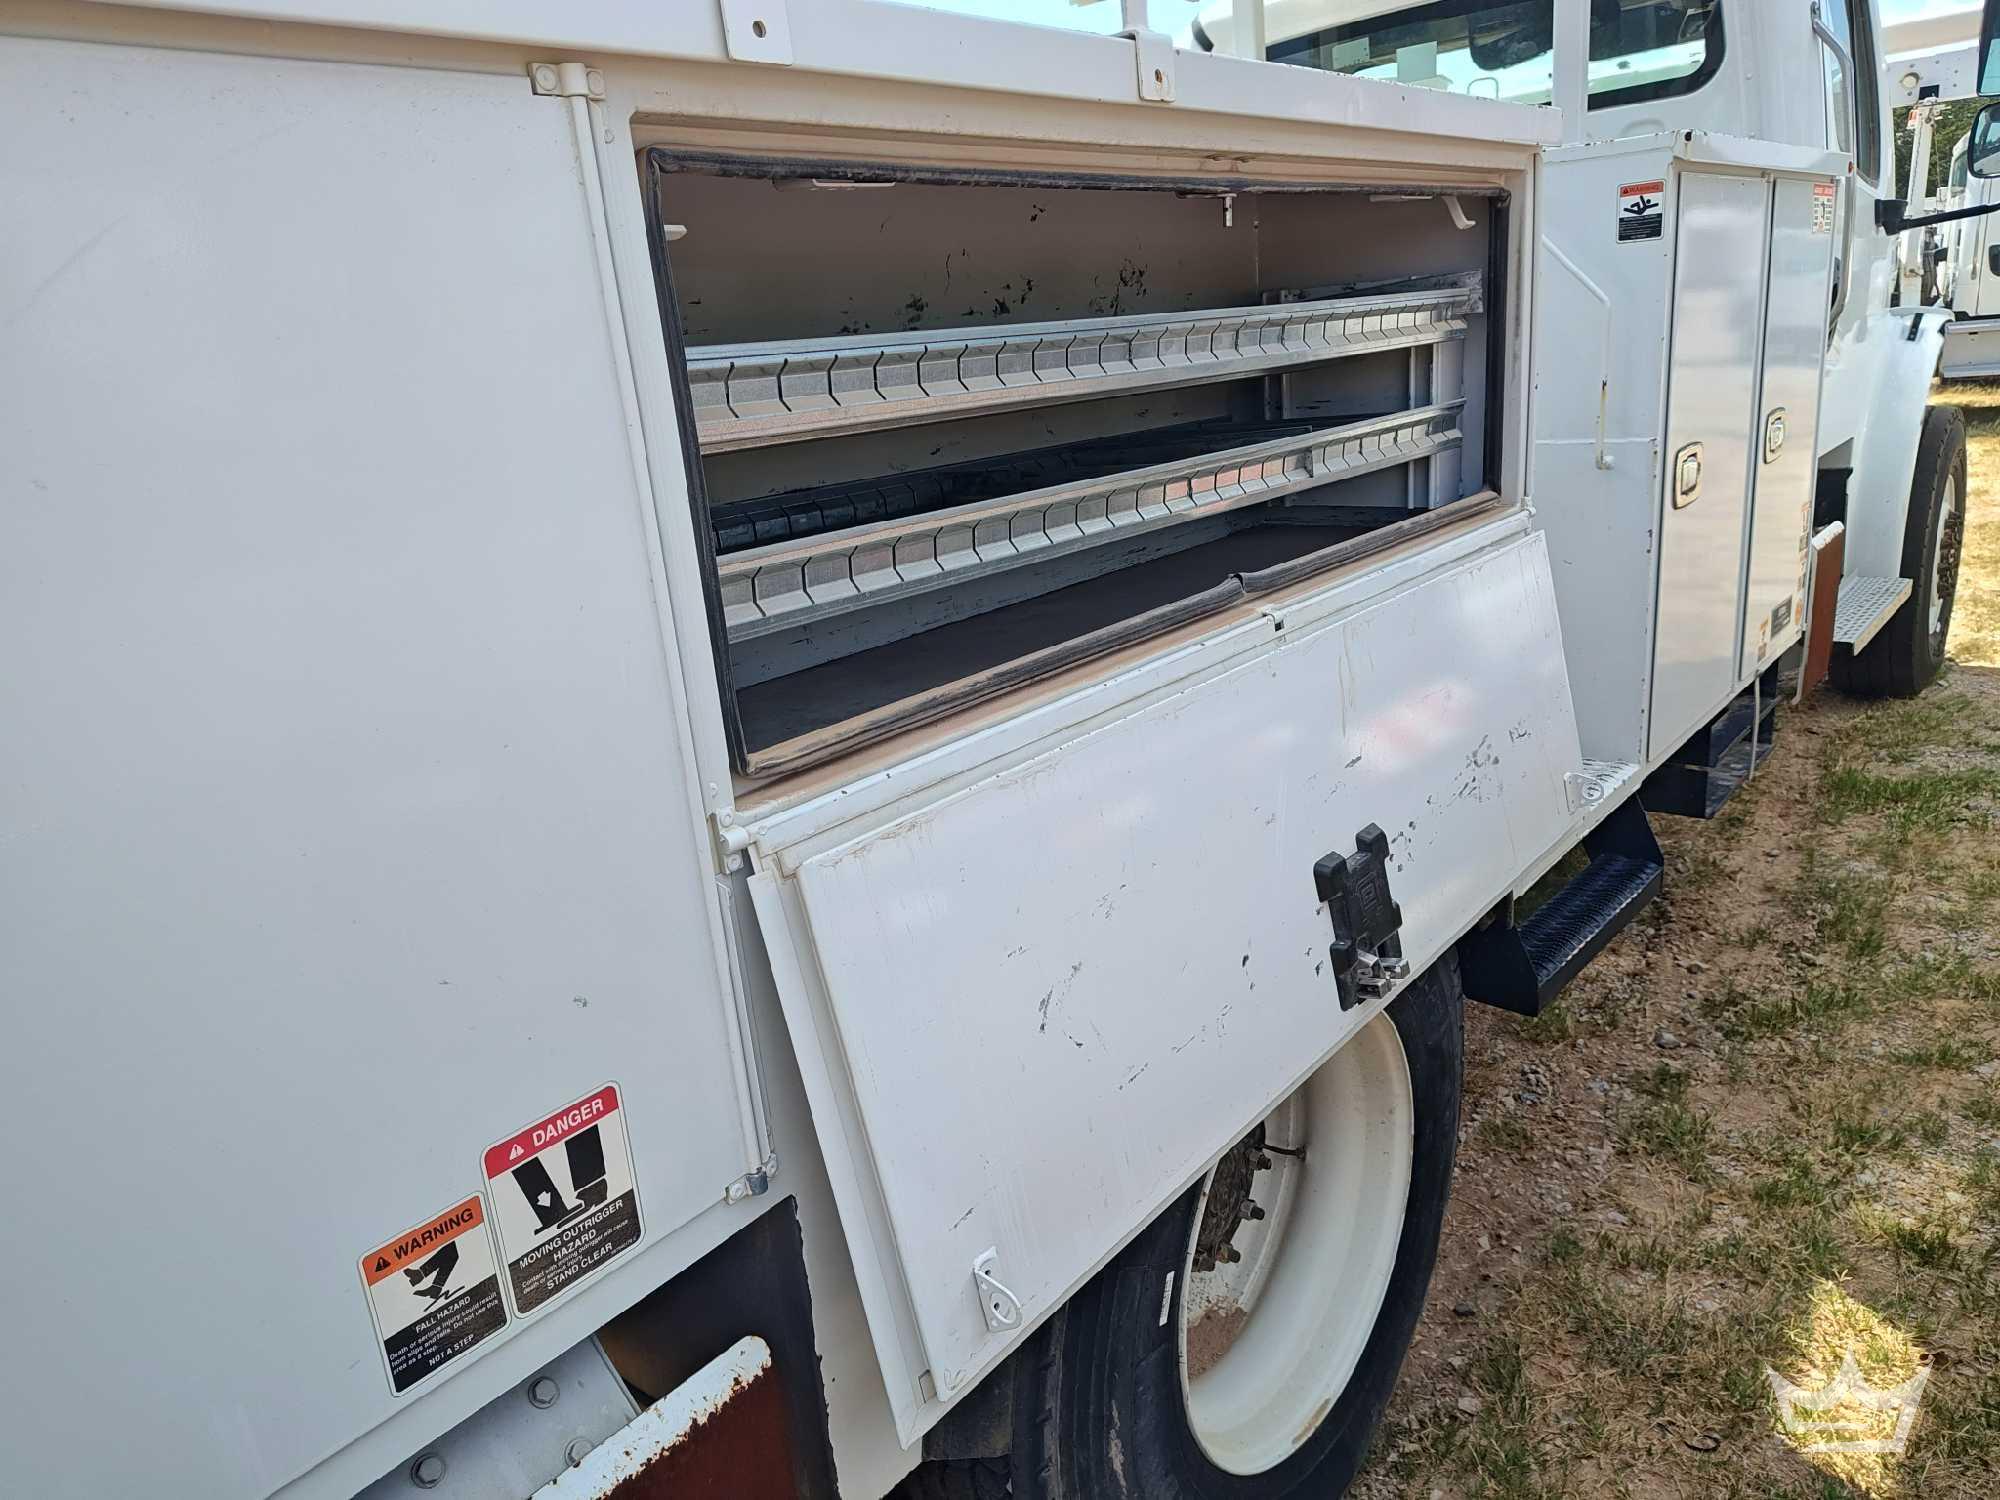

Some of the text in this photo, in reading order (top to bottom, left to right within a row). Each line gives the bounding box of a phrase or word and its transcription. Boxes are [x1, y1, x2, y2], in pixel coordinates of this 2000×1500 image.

[532, 1098, 604, 1146] DANGER
[394, 1208, 474, 1261] WARNING
[519, 1238, 561, 1269] MOVING
[563, 1200, 623, 1240] OUTRIGGER
[553, 1229, 596, 1262] HAZARD
[546, 1263, 579, 1290] STAND
[580, 1242, 613, 1268] CLEAR
[415, 1296, 471, 1334] FALL HAZARD
[453, 1320, 463, 1329] Do
[486, 1299, 499, 1310] this
[428, 1334, 474, 1367] NOT A STEP
